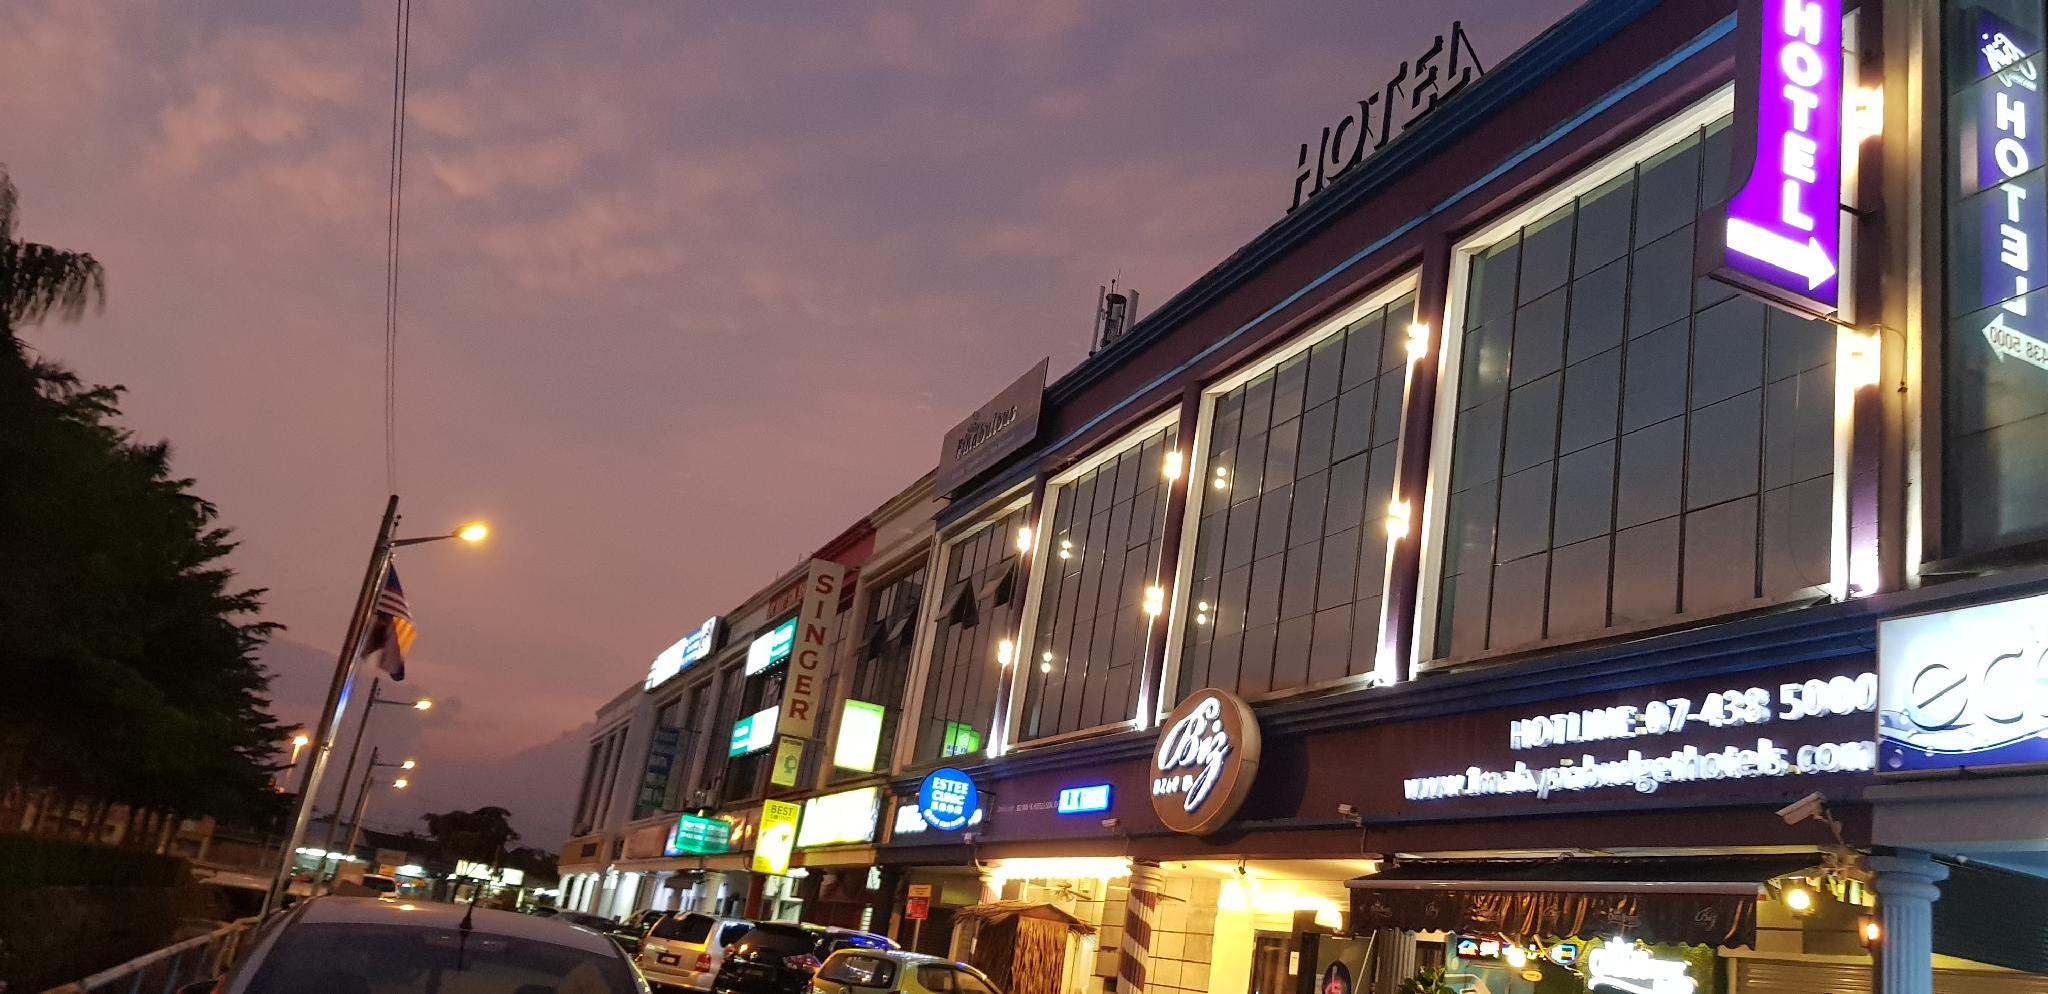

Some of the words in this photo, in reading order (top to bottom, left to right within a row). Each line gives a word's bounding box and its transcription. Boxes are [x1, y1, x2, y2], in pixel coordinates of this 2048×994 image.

[1287, 20, 1485, 214] HOTEL
[1780, 0, 1823, 231] HOTEL
[788, 574, 835, 721] SINGER
[1779, 672, 1877, 721] 5000
[1905, 640, 2048, 732] ec
[932, 777, 969, 795] ESTEE
[1158, 697, 1233, 812] Biz
[770, 804, 794, 817] BEST
